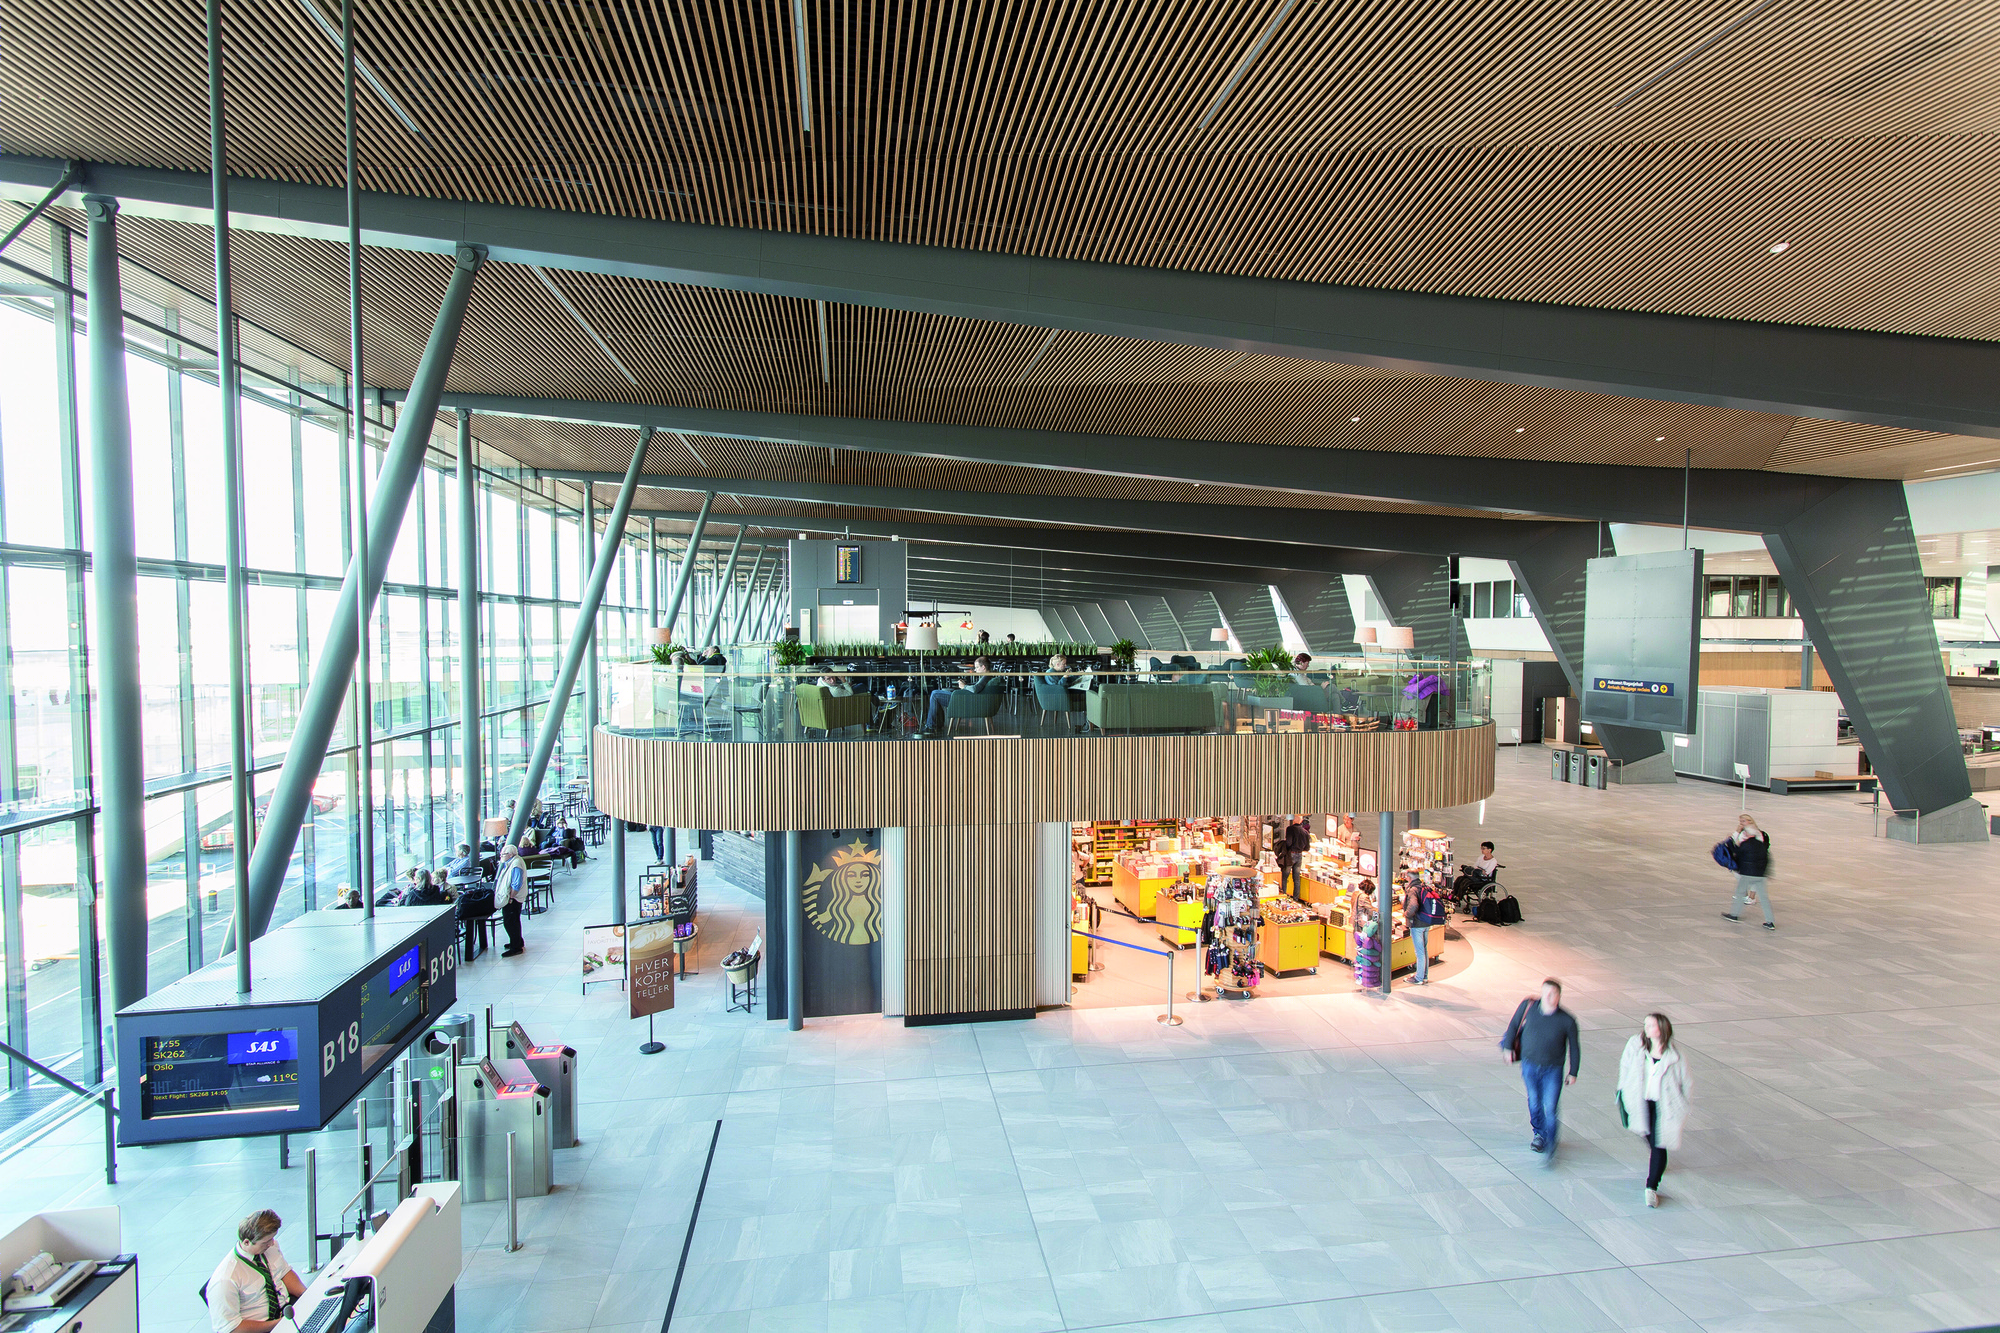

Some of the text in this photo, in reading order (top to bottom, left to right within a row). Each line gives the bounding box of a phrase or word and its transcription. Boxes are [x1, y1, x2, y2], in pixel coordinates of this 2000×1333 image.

[397, 957, 412, 978] SAS
[430, 944, 454, 986] B18
[635, 957, 669, 974] HVER
[635, 971, 670, 988] KOPP
[636, 984, 670, 998] TELLER
[153, 1040, 280, 1053] 11:55 SAS
[323, 1021, 359, 1078] B18
[153, 1050, 185, 1060] SK262
[153, 1063, 174, 1071] Oslo
[272, 1072, 298, 1083] 11°C
[169, 1092, 188, 1100] Flight:
